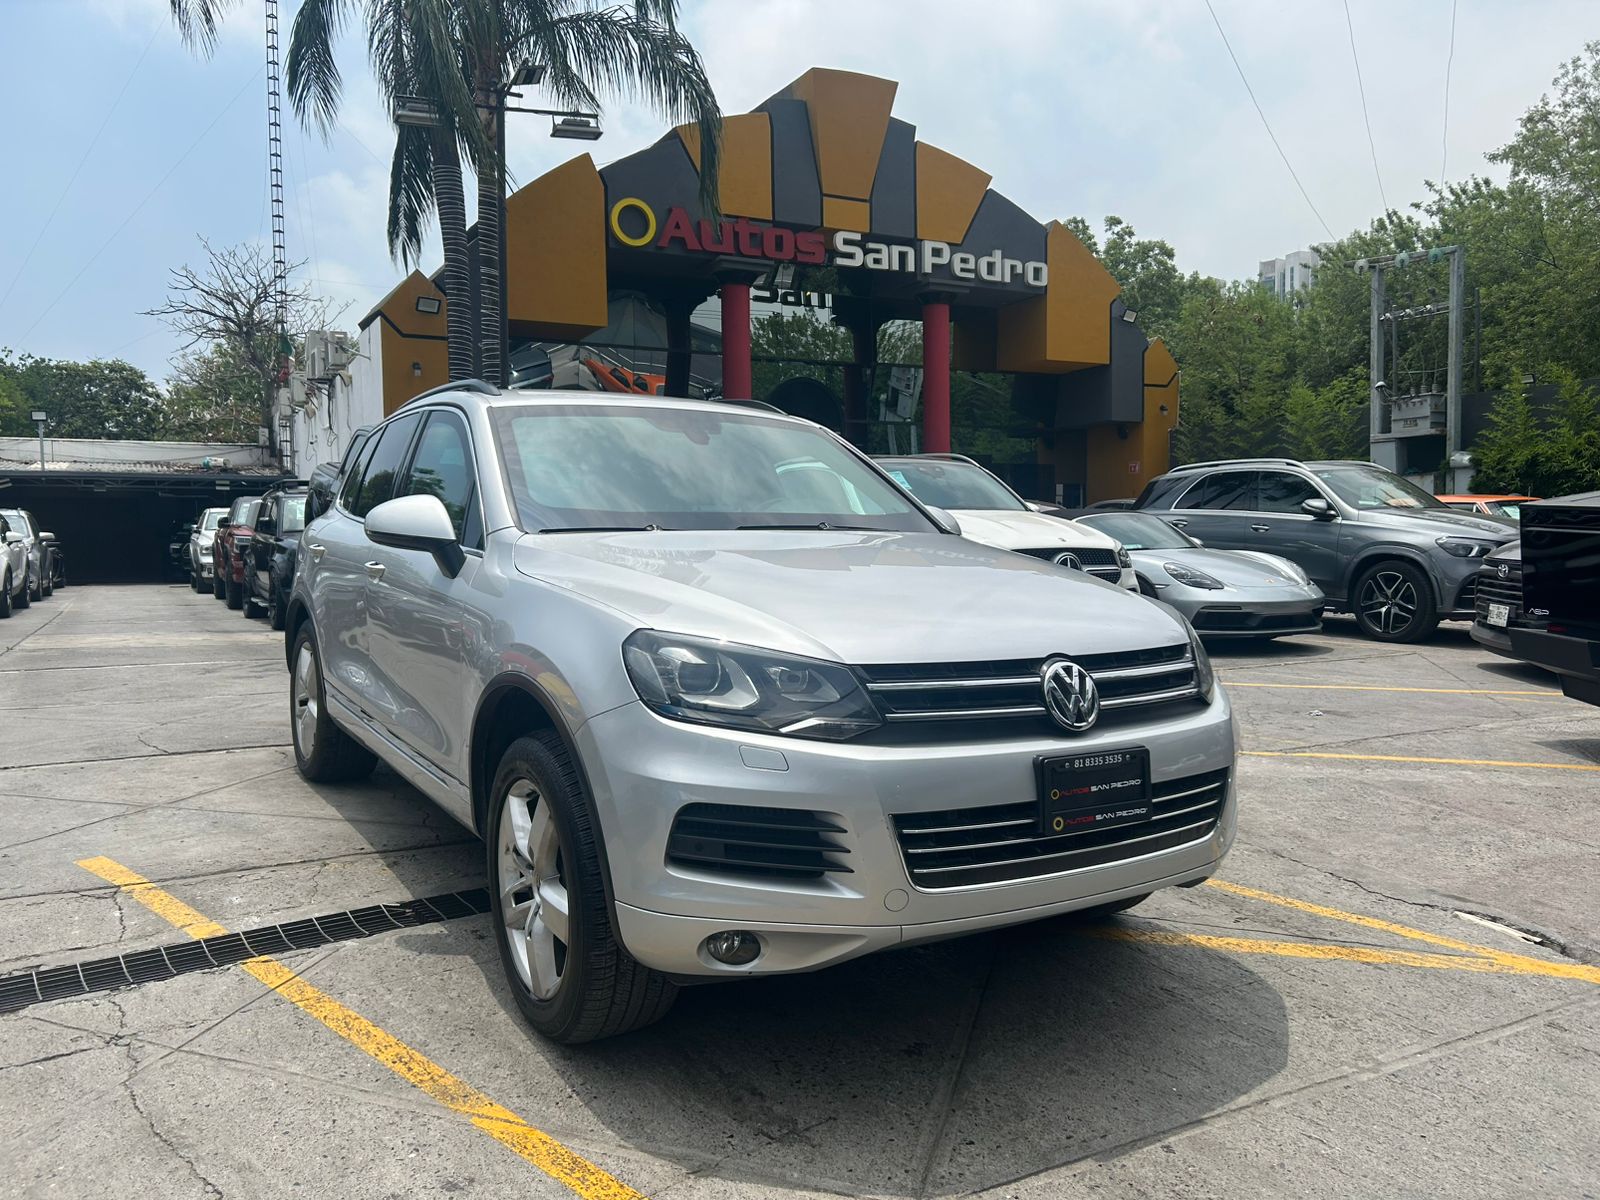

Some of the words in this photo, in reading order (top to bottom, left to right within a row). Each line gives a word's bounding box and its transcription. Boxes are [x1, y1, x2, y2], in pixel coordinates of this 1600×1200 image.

[657, 206, 826, 264] Autos
[833, 231, 915, 272] San
[922, 240, 1048, 287] Pedro
[1074, 759, 1083, 768] 81
[1085, 756, 1103, 767] 8335
[1104, 754, 1122, 764] 3535
[1090, 784, 1110, 792] SAN
[1110, 779, 1141, 788] PEDRO
[1095, 812, 1115, 820] SAN
[1115, 807, 1146, 817] PEDRO
